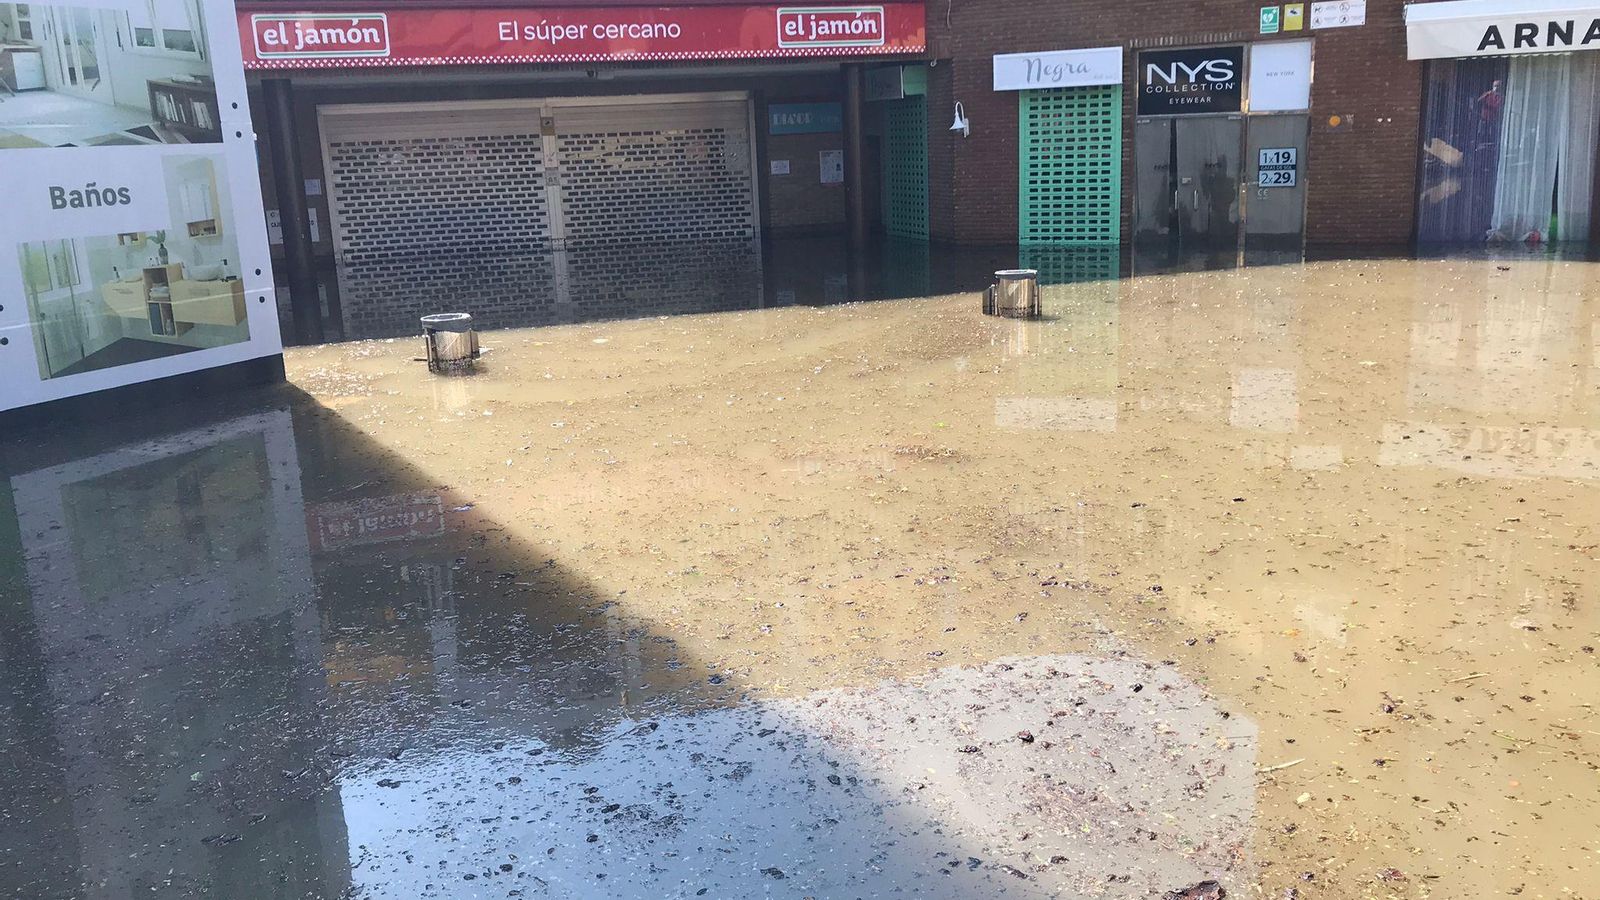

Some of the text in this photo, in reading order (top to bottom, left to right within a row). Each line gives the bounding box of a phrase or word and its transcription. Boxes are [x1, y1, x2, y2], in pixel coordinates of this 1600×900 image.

[263, 19, 380, 50] el jamón
[498, 20, 681, 45] El súper cercano
[785, 11, 877, 40] el jamón
[1477, 19, 1600, 51] ARNA
[1023, 58, 1090, 84] Negra
[1146, 59, 1234, 85] NYS
[1169, 96, 1212, 105] EYEWEAR
[49, 181, 131, 210] Baños
